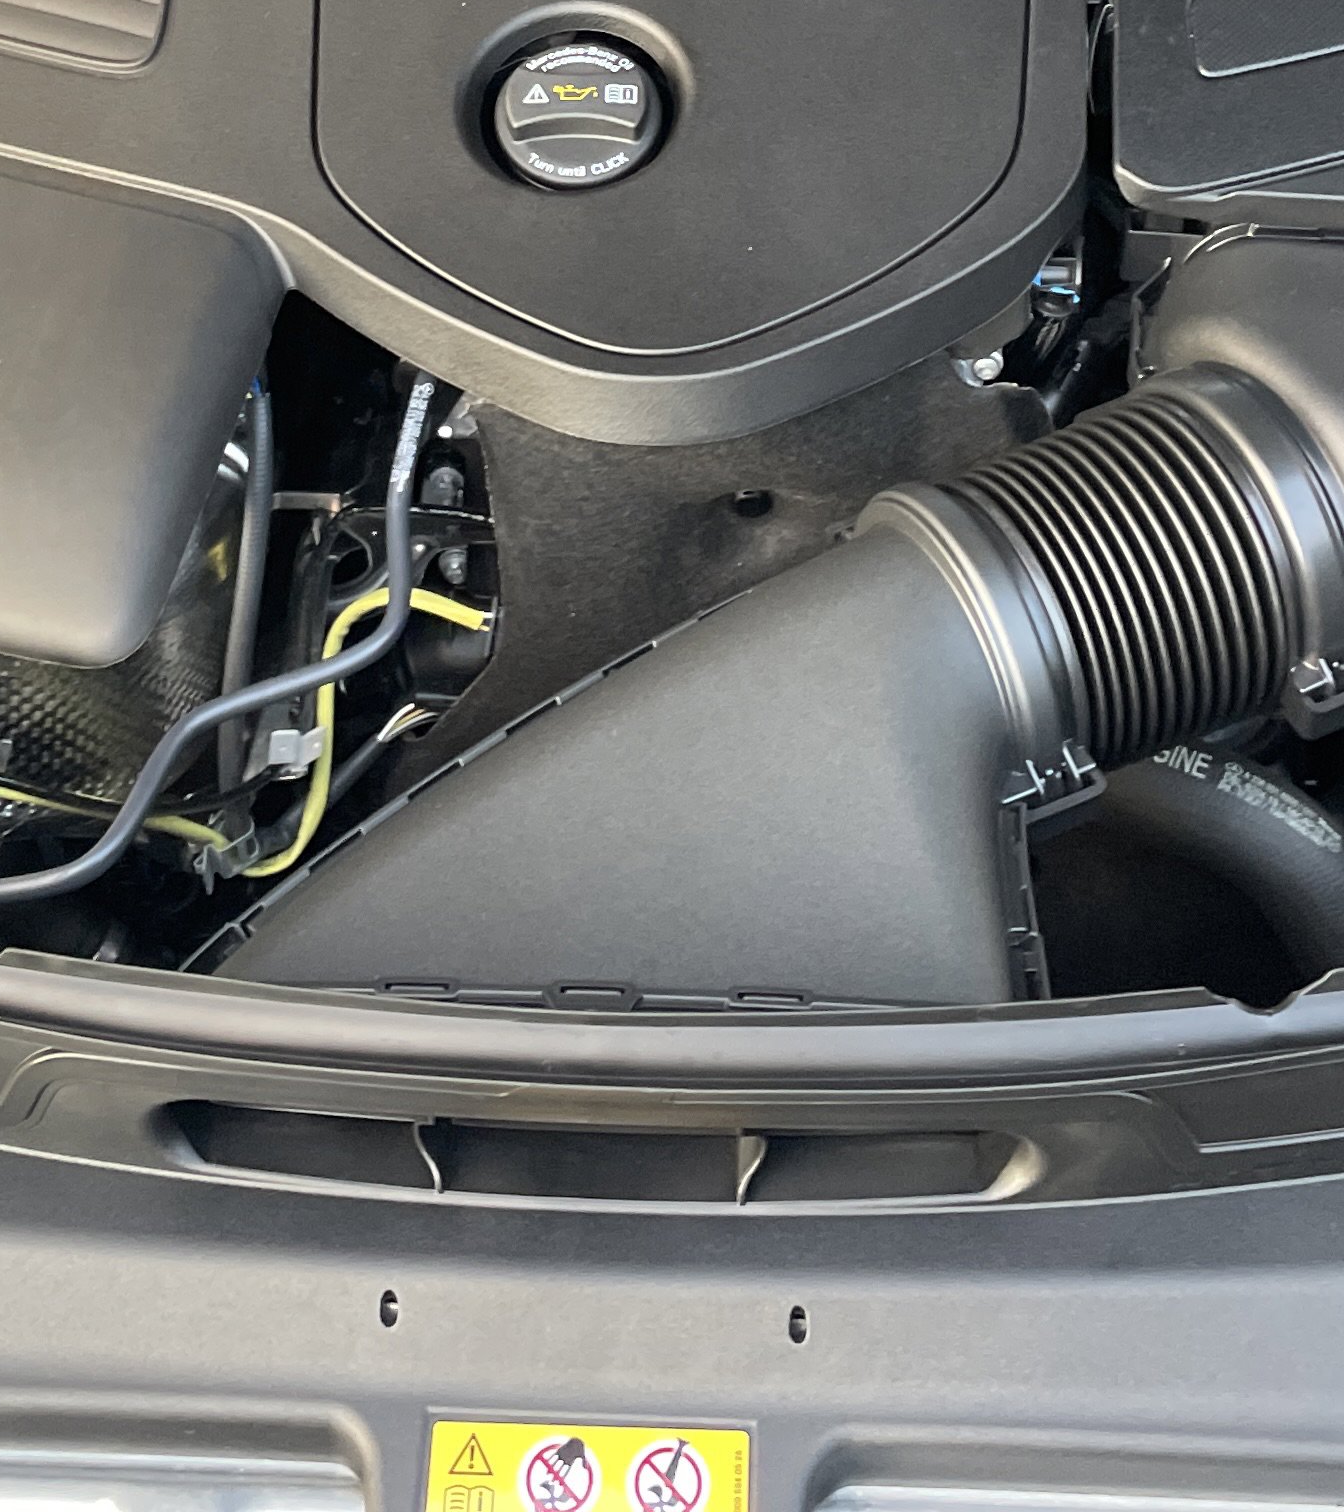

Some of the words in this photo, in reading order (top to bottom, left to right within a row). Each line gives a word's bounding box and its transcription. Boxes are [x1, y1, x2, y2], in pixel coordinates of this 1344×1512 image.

[528, 152, 555, 174] Turn
[557, 165, 587, 177] until
[590, 151, 630, 175] CLICK
